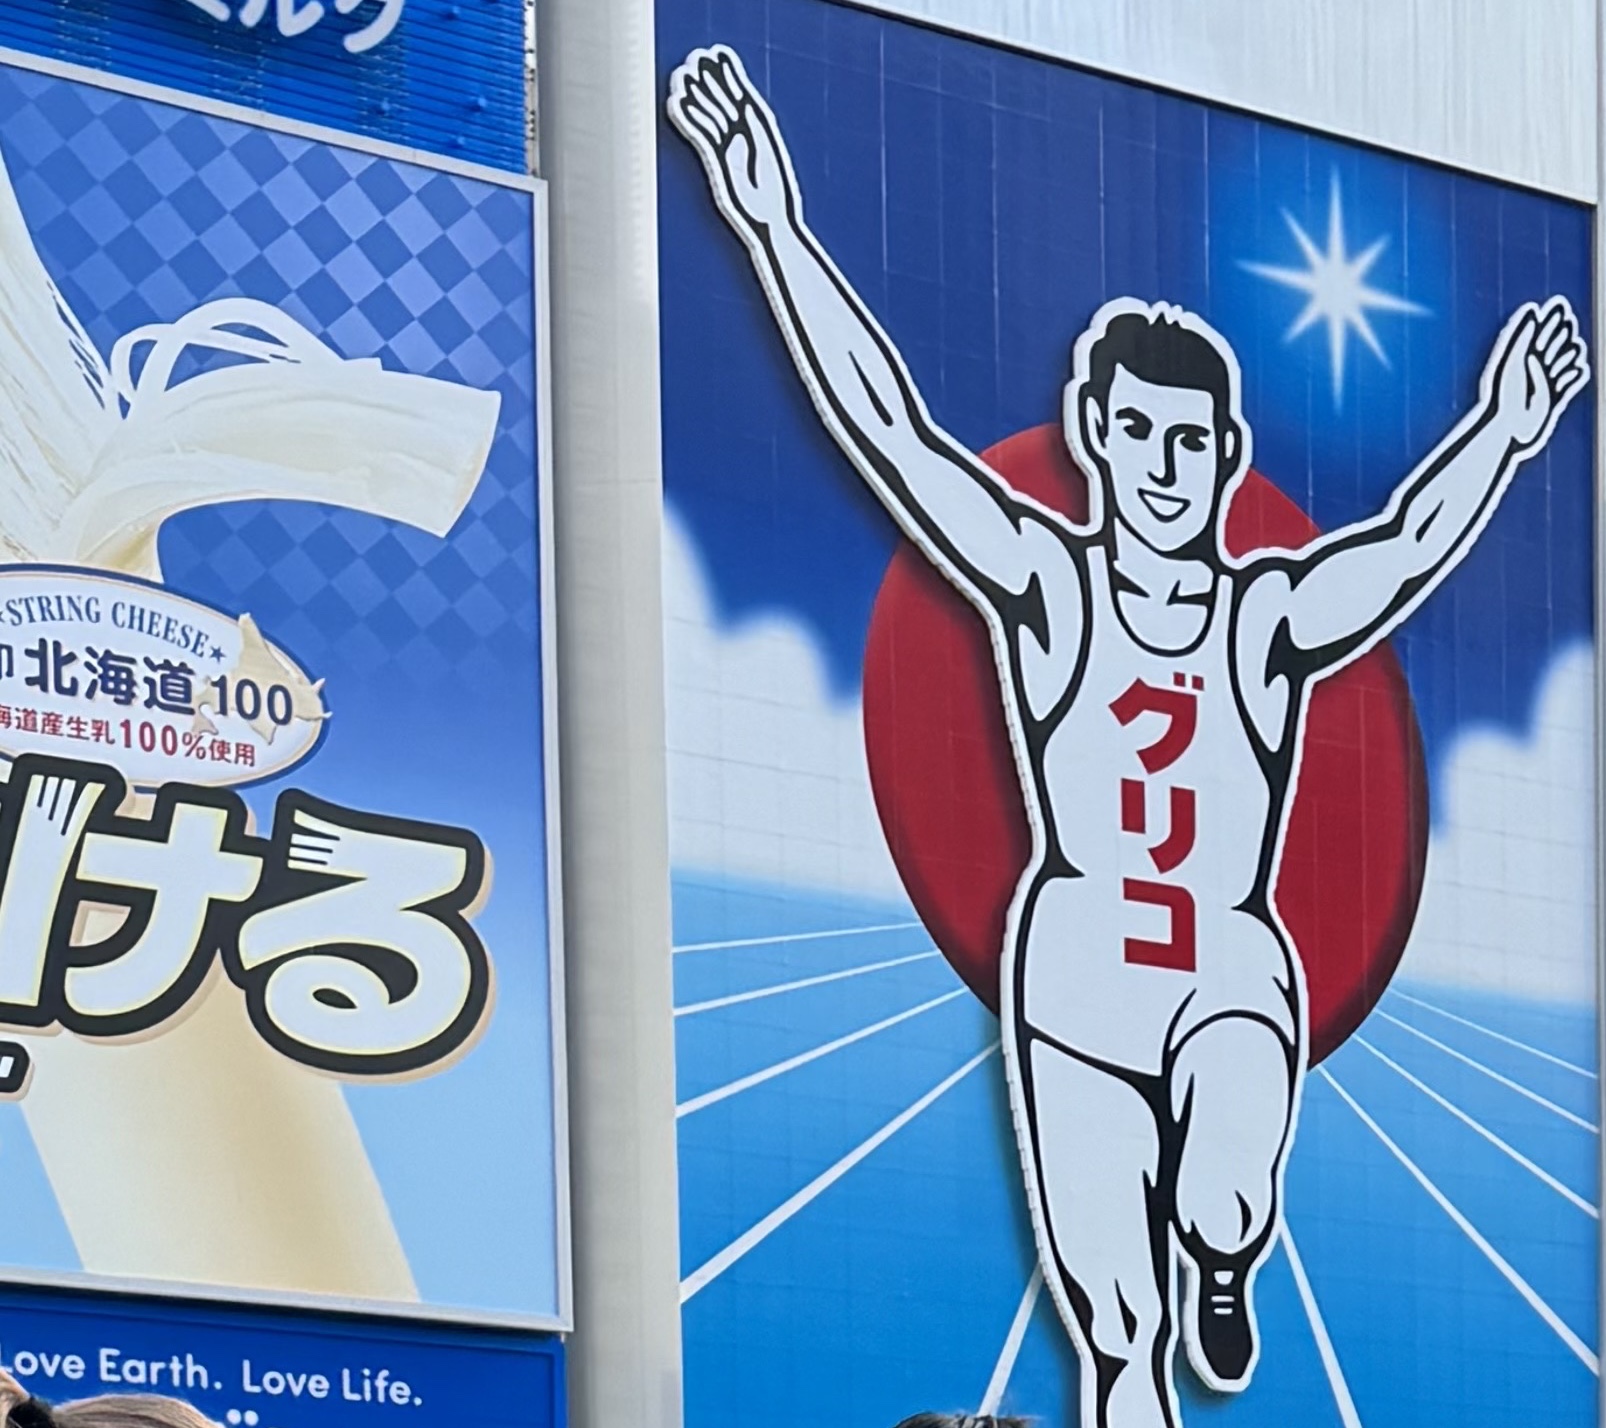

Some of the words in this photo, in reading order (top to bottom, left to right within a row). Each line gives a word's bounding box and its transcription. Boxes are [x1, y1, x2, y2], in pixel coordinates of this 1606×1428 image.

[6, 595, 101, 627] STRING
[111, 601, 209, 658] CHEESE
[1108, 671, 1205, 973] グリコ
[0, 1350, 86, 1380] ove
[99, 1347, 223, 1390] Earth.
[242, 1359, 330, 1399] Love
[342, 1367, 424, 1407] Life.
